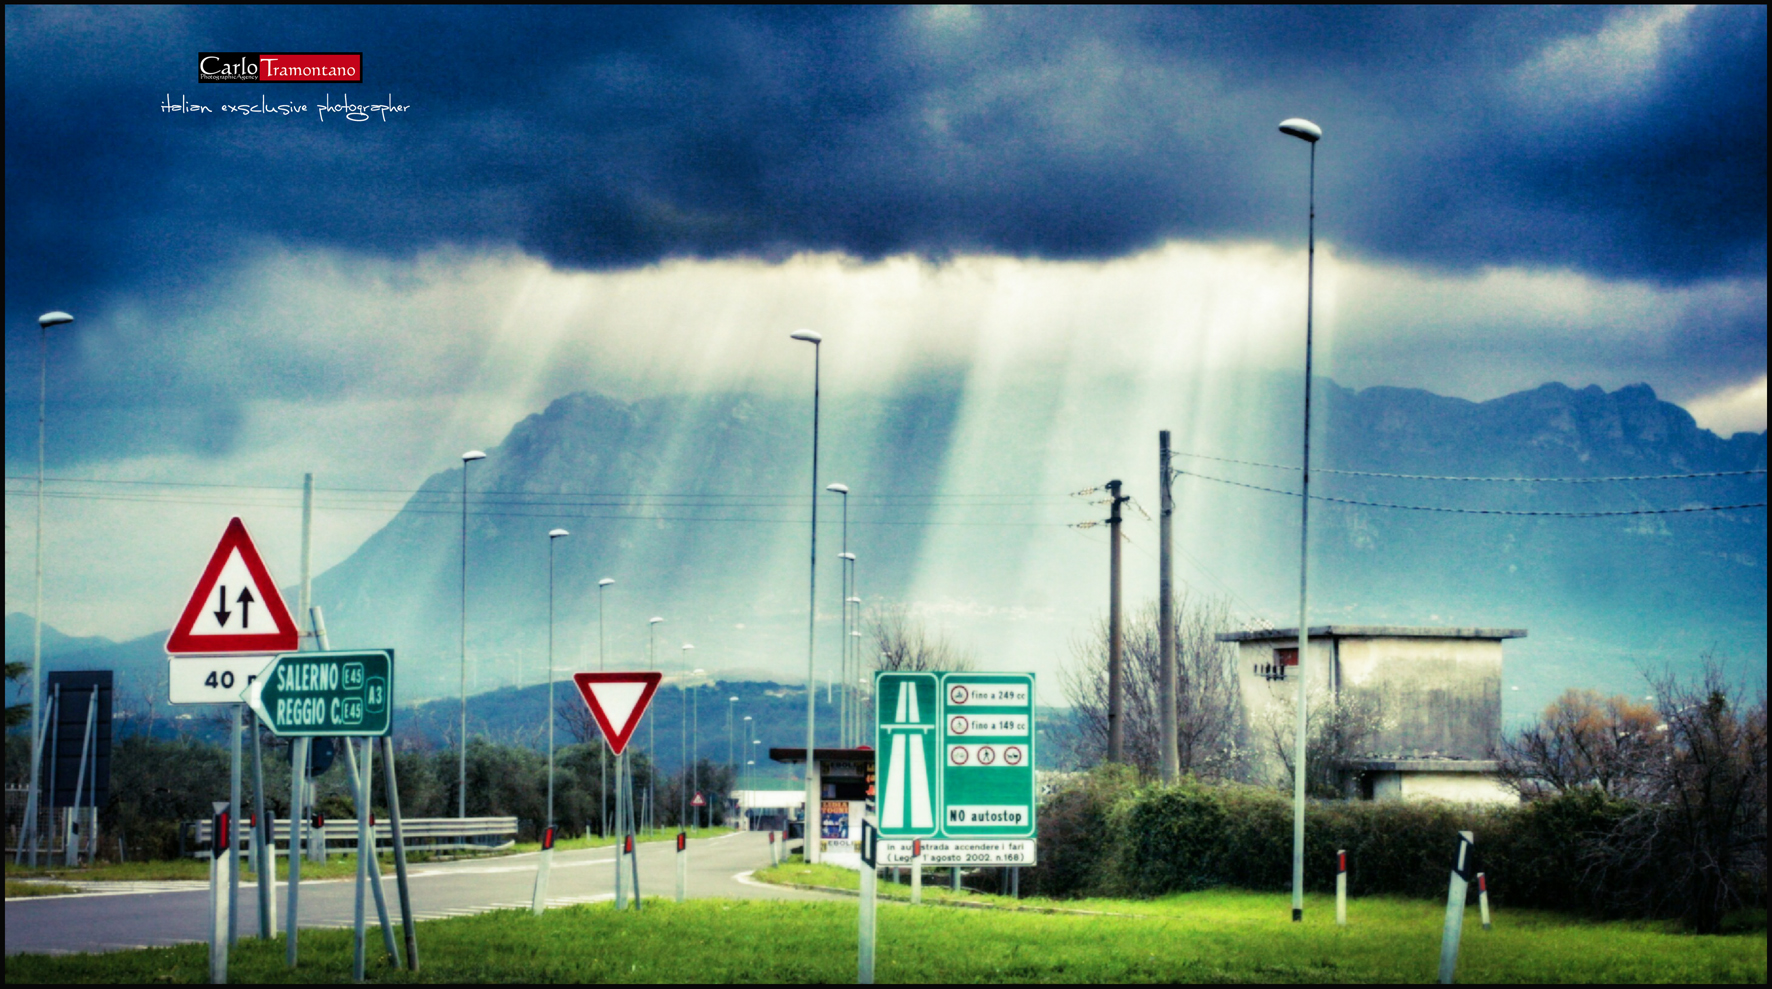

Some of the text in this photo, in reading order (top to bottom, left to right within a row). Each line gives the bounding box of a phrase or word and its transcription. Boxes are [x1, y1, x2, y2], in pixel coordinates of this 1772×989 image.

[205, 671, 235, 689] 40
[276, 663, 339, 691] SALERNO
[367, 685, 383, 704] A3
[971, 690, 988, 700] fino
[998, 690, 1015, 700] 249
[276, 697, 326, 725] REGGIO
[330, 697, 342, 725] C.
[971, 720, 988, 730] fino
[998, 720, 1015, 730] 149
[950, 809, 1022, 825] NO autostop
[887, 843, 896, 851] in
[900, 843, 950, 851] austrada
[954, 843, 1000, 851] accendere
[1008, 842, 1025, 851] fari
[930, 854, 962, 863] agosto
